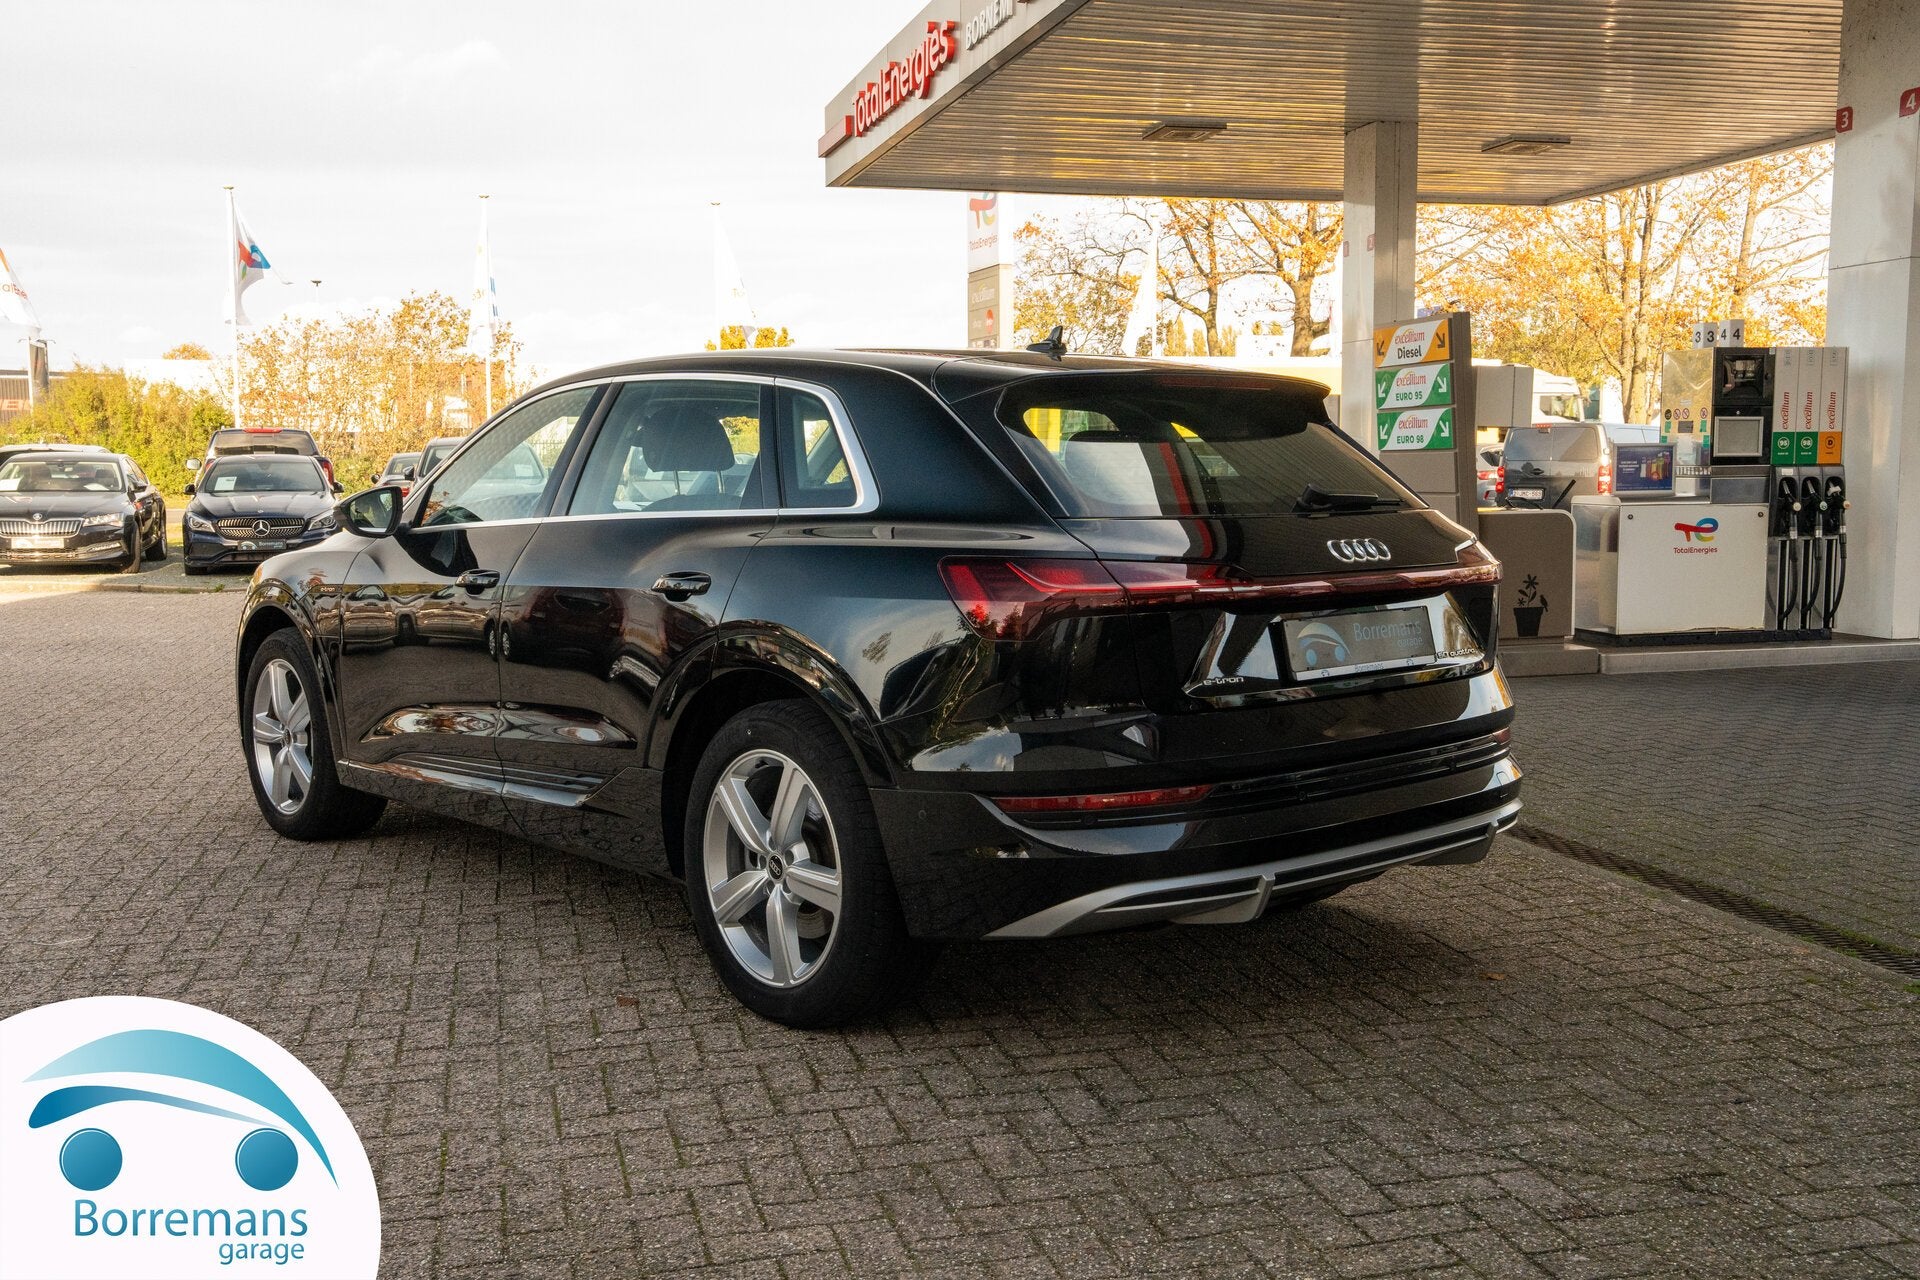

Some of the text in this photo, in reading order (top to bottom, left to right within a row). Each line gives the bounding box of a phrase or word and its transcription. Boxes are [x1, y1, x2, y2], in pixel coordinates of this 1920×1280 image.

[853, 0, 1013, 137] TotalEnergies BORNEM
[1906, 93, 1916, 110] 4
[1841, 111, 1849, 128] 3
[1394, 331, 1425, 344] excellium
[1695, 328, 1741, 343] 3 3 4 4
[1397, 345, 1422, 359] Diesel
[1396, 374, 1426, 387] excellium
[1395, 391, 1423, 402] EURO 95
[1781, 391, 1790, 430] excellium
[1804, 391, 1813, 430] excellium
[1828, 391, 1837, 430] excellium
[1398, 418, 1428, 430] excellium
[1396, 434, 1424, 444] EURO 98
[1674, 546, 1717, 554] TotalEnergies
[1353, 620, 1422, 641] Borremans
[1203, 676, 1244, 686] e-tron
